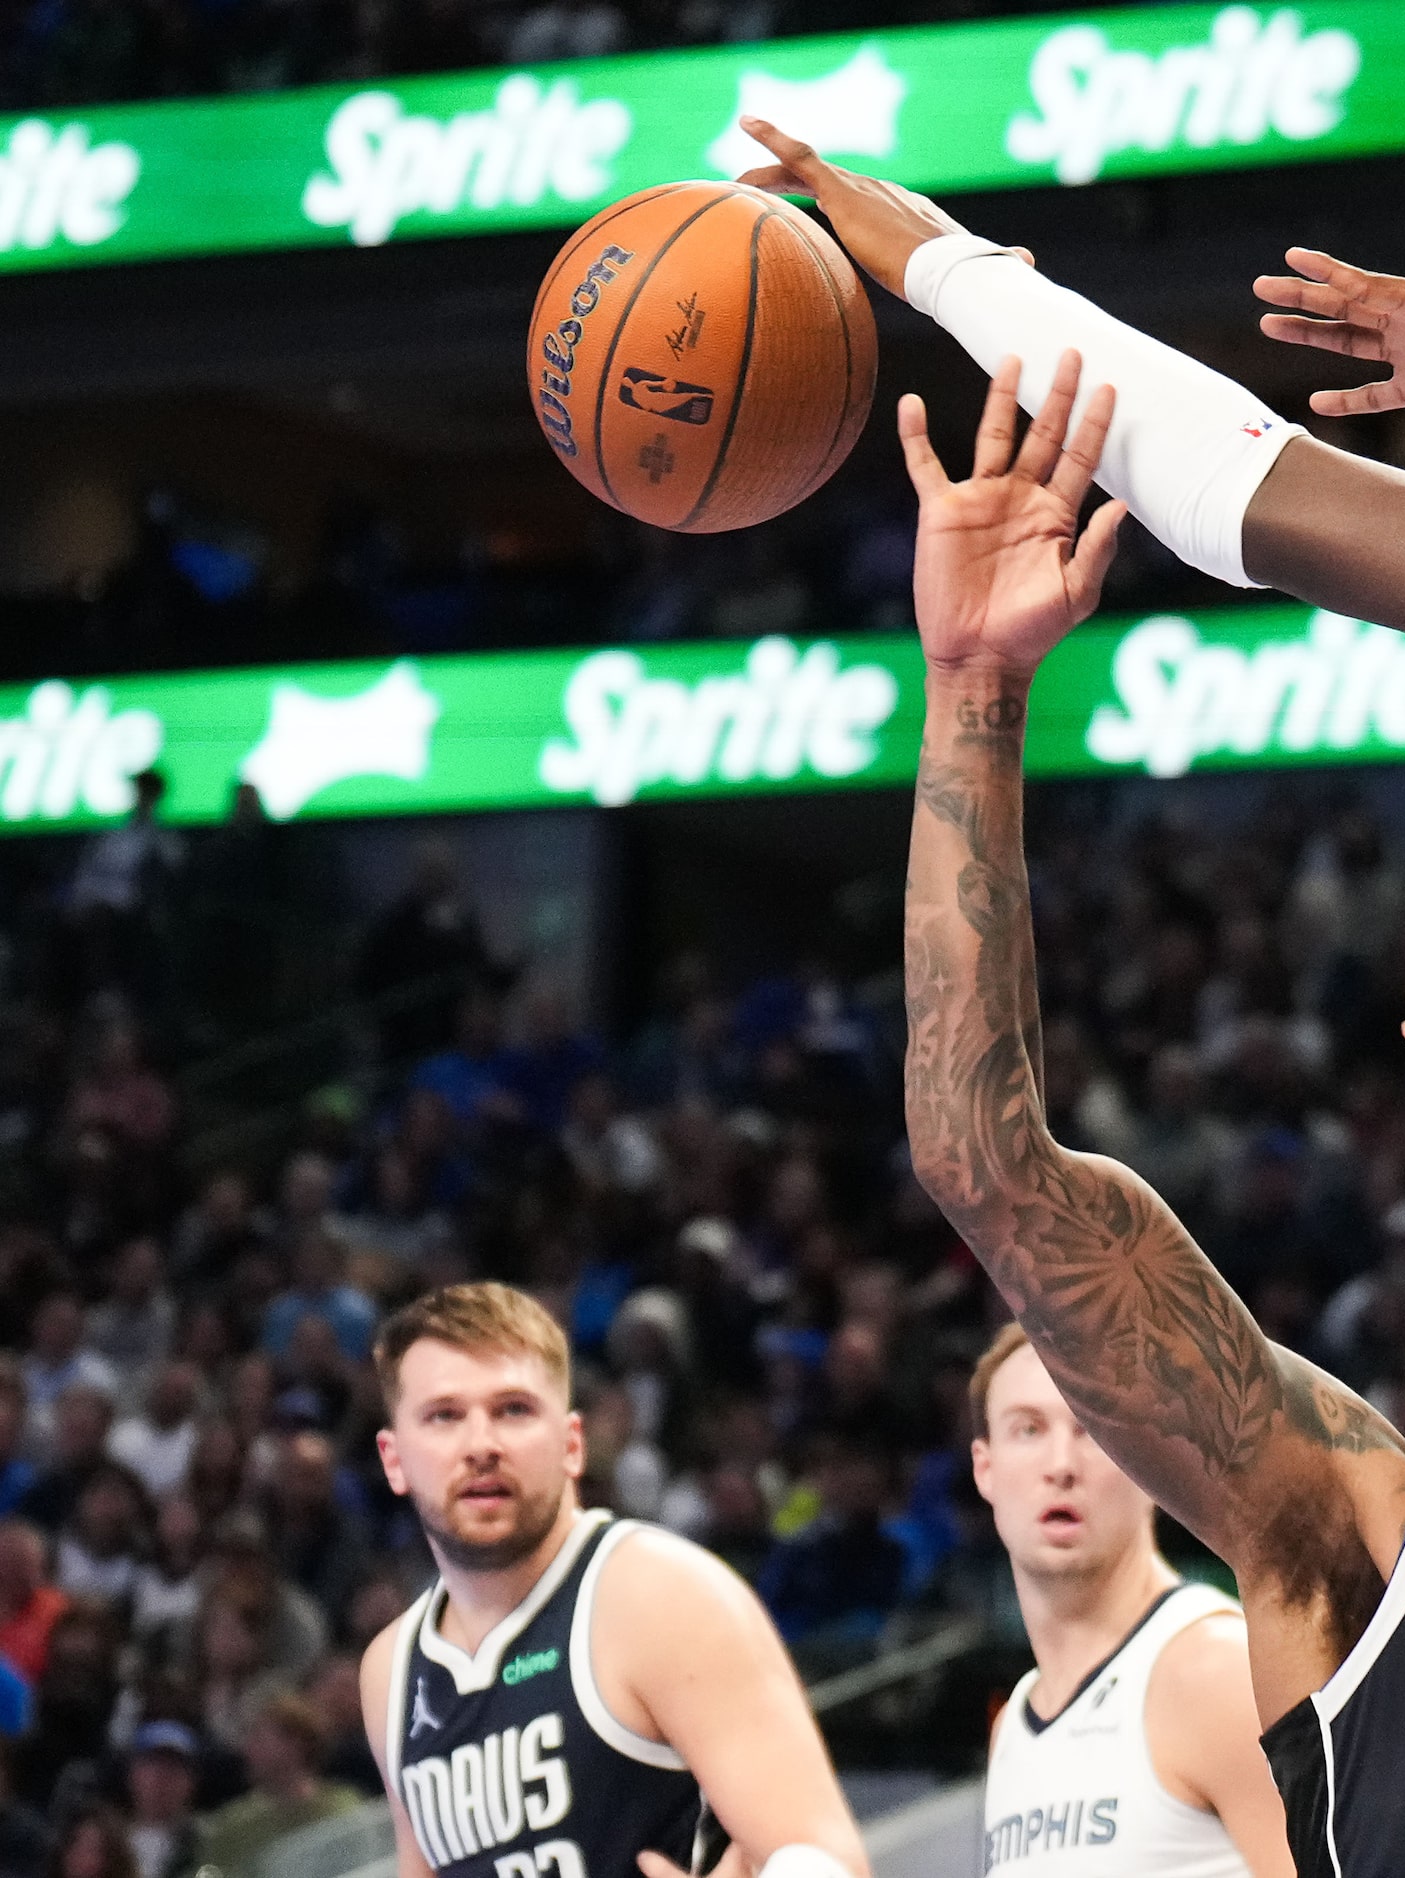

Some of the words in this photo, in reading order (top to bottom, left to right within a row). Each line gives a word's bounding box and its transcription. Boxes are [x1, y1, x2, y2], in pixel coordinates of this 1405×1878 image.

[304, 75, 631, 245] Sprite
[1005, 8, 1358, 183] Sprite
[539, 243, 635, 458] Wilson
[539, 638, 897, 806] Sprite
